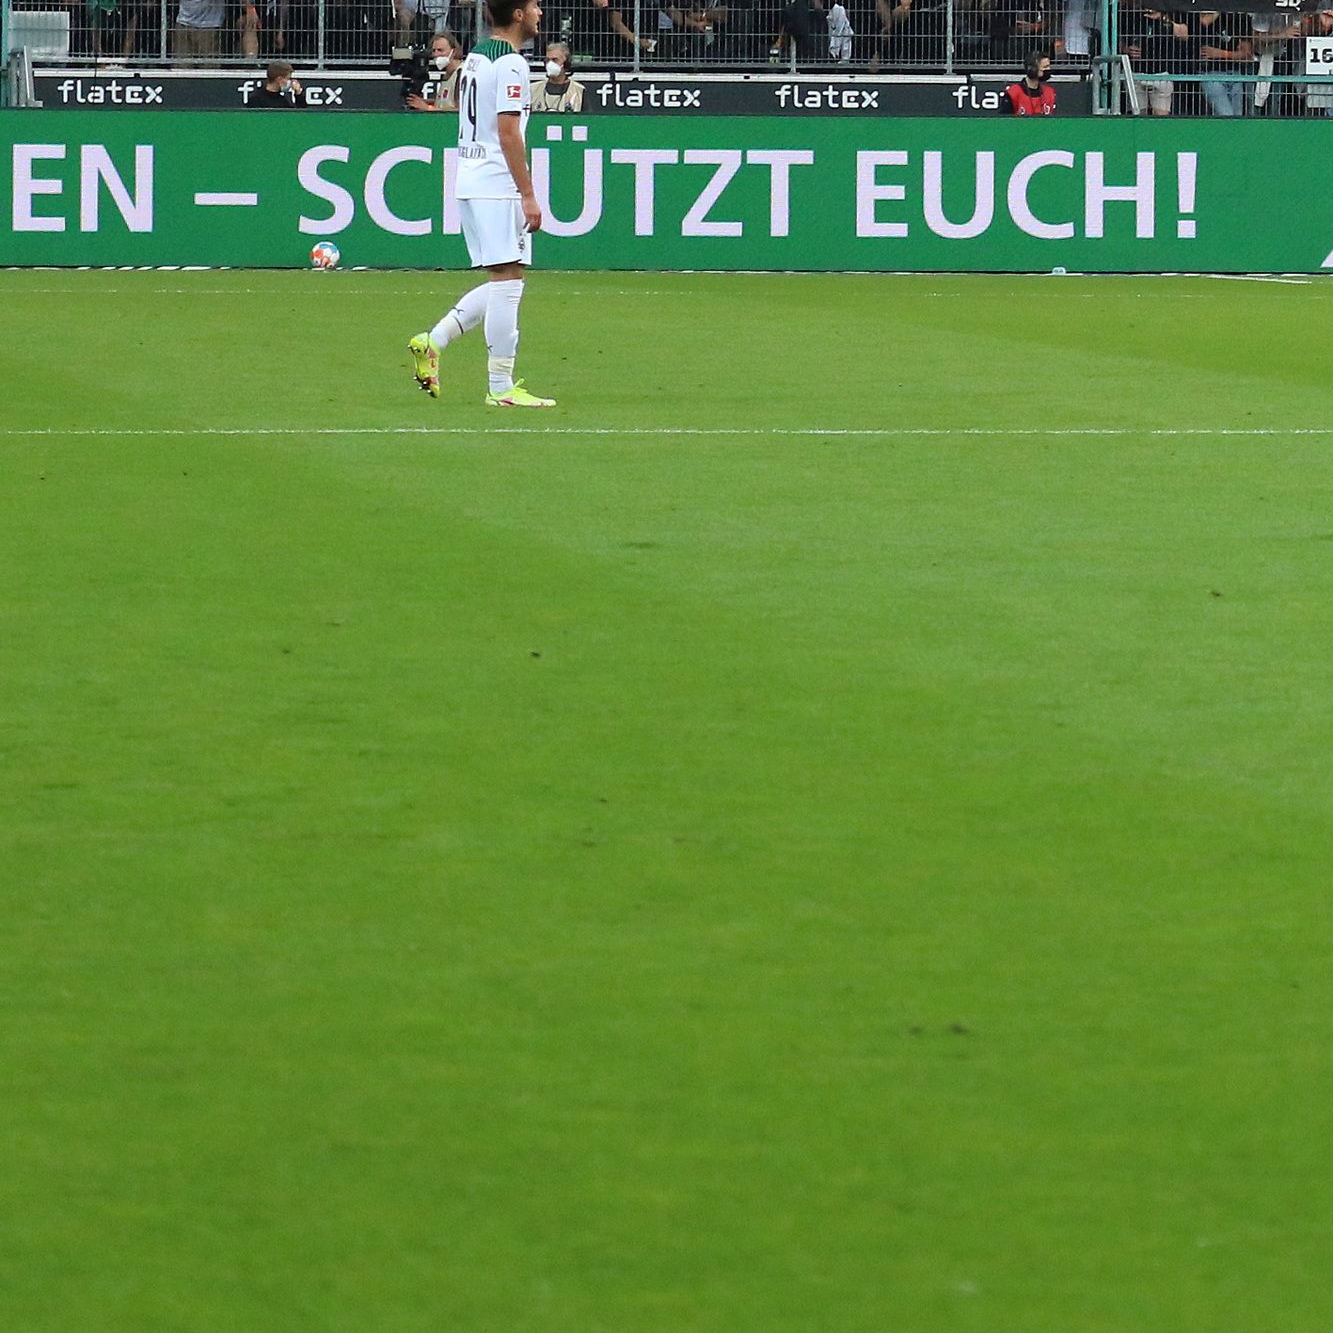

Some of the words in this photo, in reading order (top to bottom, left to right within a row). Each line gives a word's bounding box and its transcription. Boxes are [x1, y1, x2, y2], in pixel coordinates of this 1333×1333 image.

[57, 79, 163, 104] flatex
[597, 83, 700, 107] flatex
[775, 84, 879, 108] flatex
[12, 145, 154, 232] EN
[856, 151, 1197, 239] EUCH!
